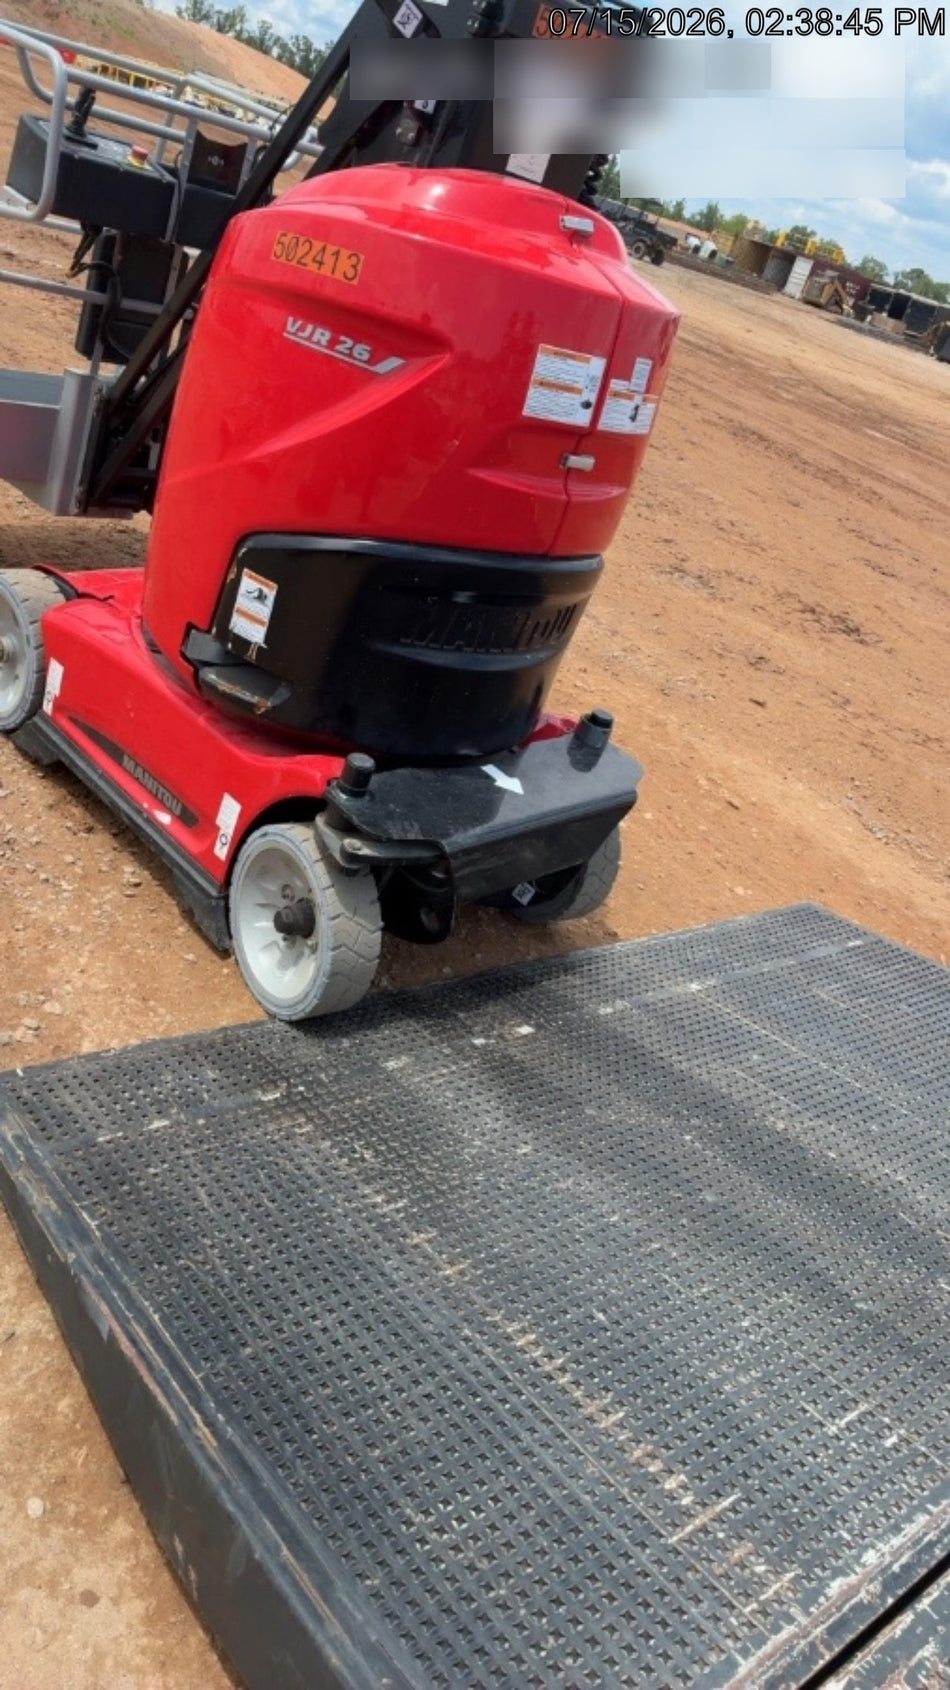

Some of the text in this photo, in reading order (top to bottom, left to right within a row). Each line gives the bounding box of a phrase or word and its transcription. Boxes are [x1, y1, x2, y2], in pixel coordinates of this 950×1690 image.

[273, 232, 361, 281] 502413
[286, 316, 371, 361] VJR 26
[122, 754, 183, 816] MANITOU
